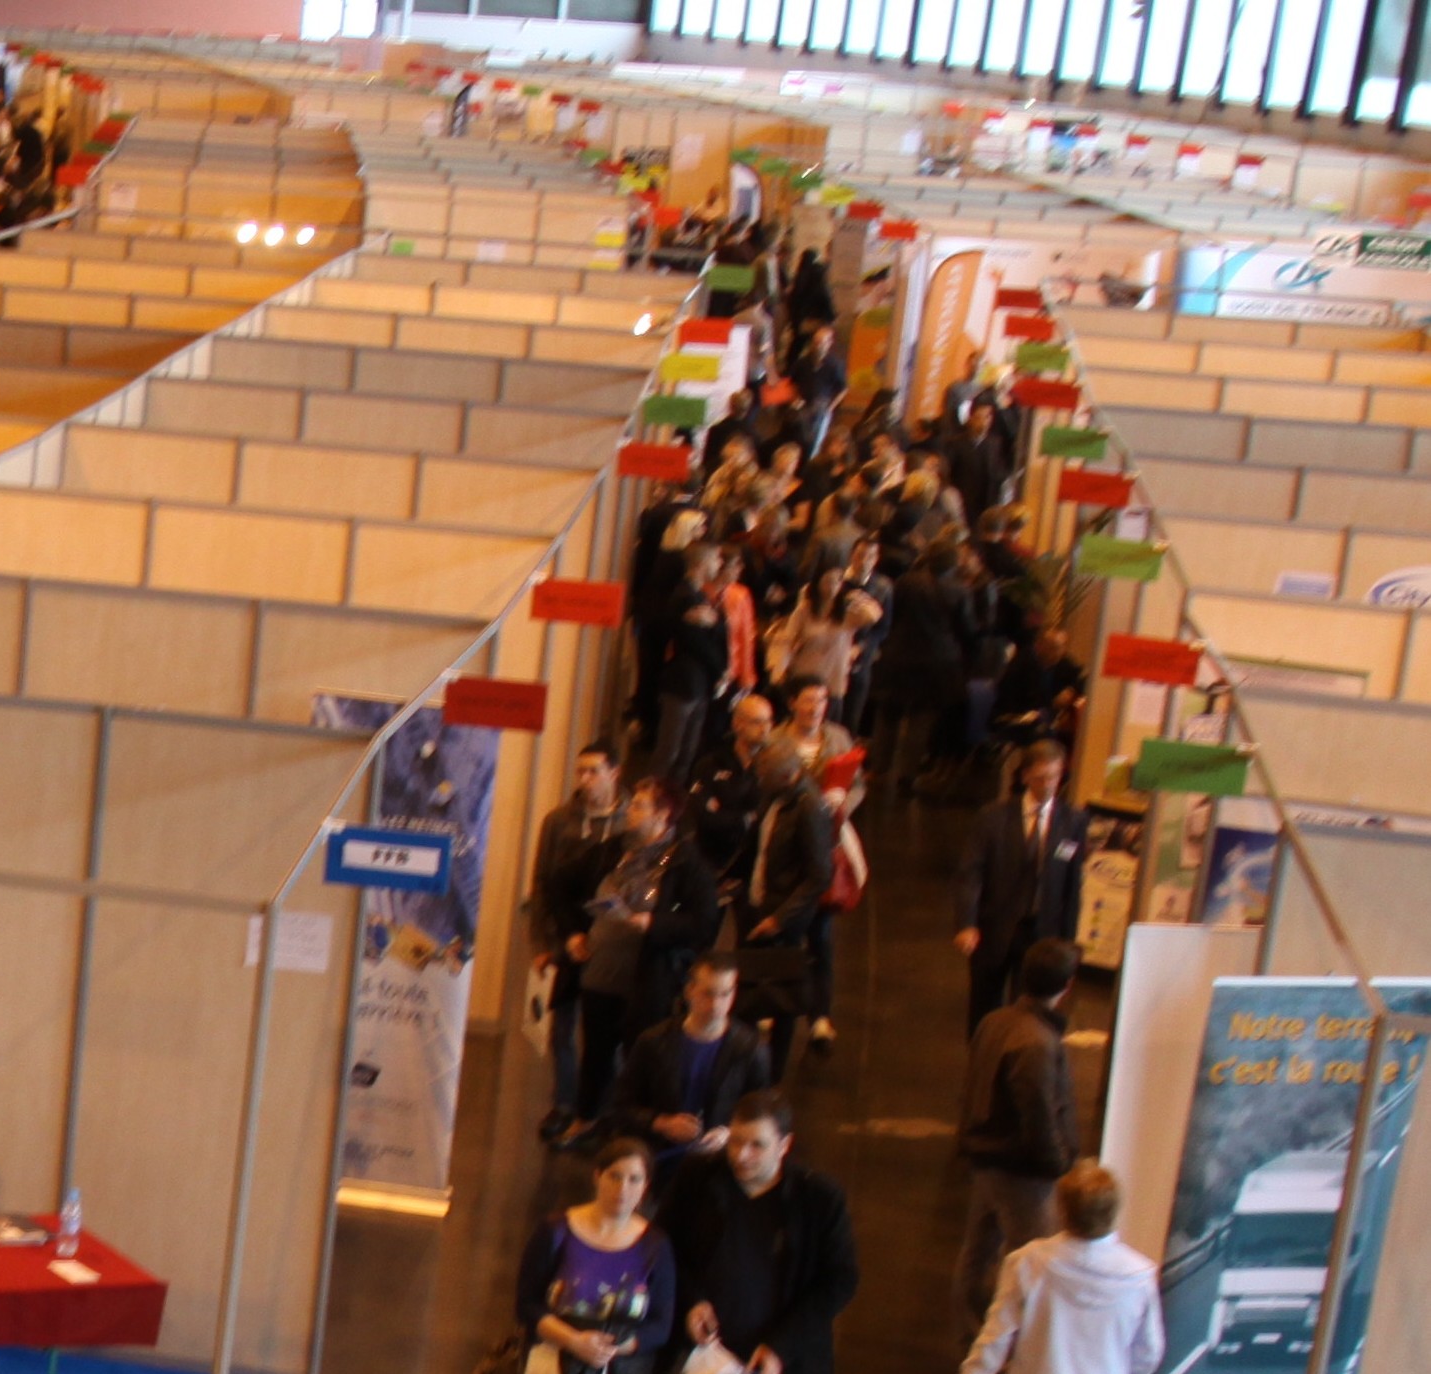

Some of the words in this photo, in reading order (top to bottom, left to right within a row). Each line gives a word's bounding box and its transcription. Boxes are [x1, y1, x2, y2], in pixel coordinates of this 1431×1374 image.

[1228, 1011, 1307, 1042] Notre
[1208, 1055, 1280, 1086] c'est
[1285, 1054, 1315, 1085] la
[1323, 1060, 1400, 1086] roue
